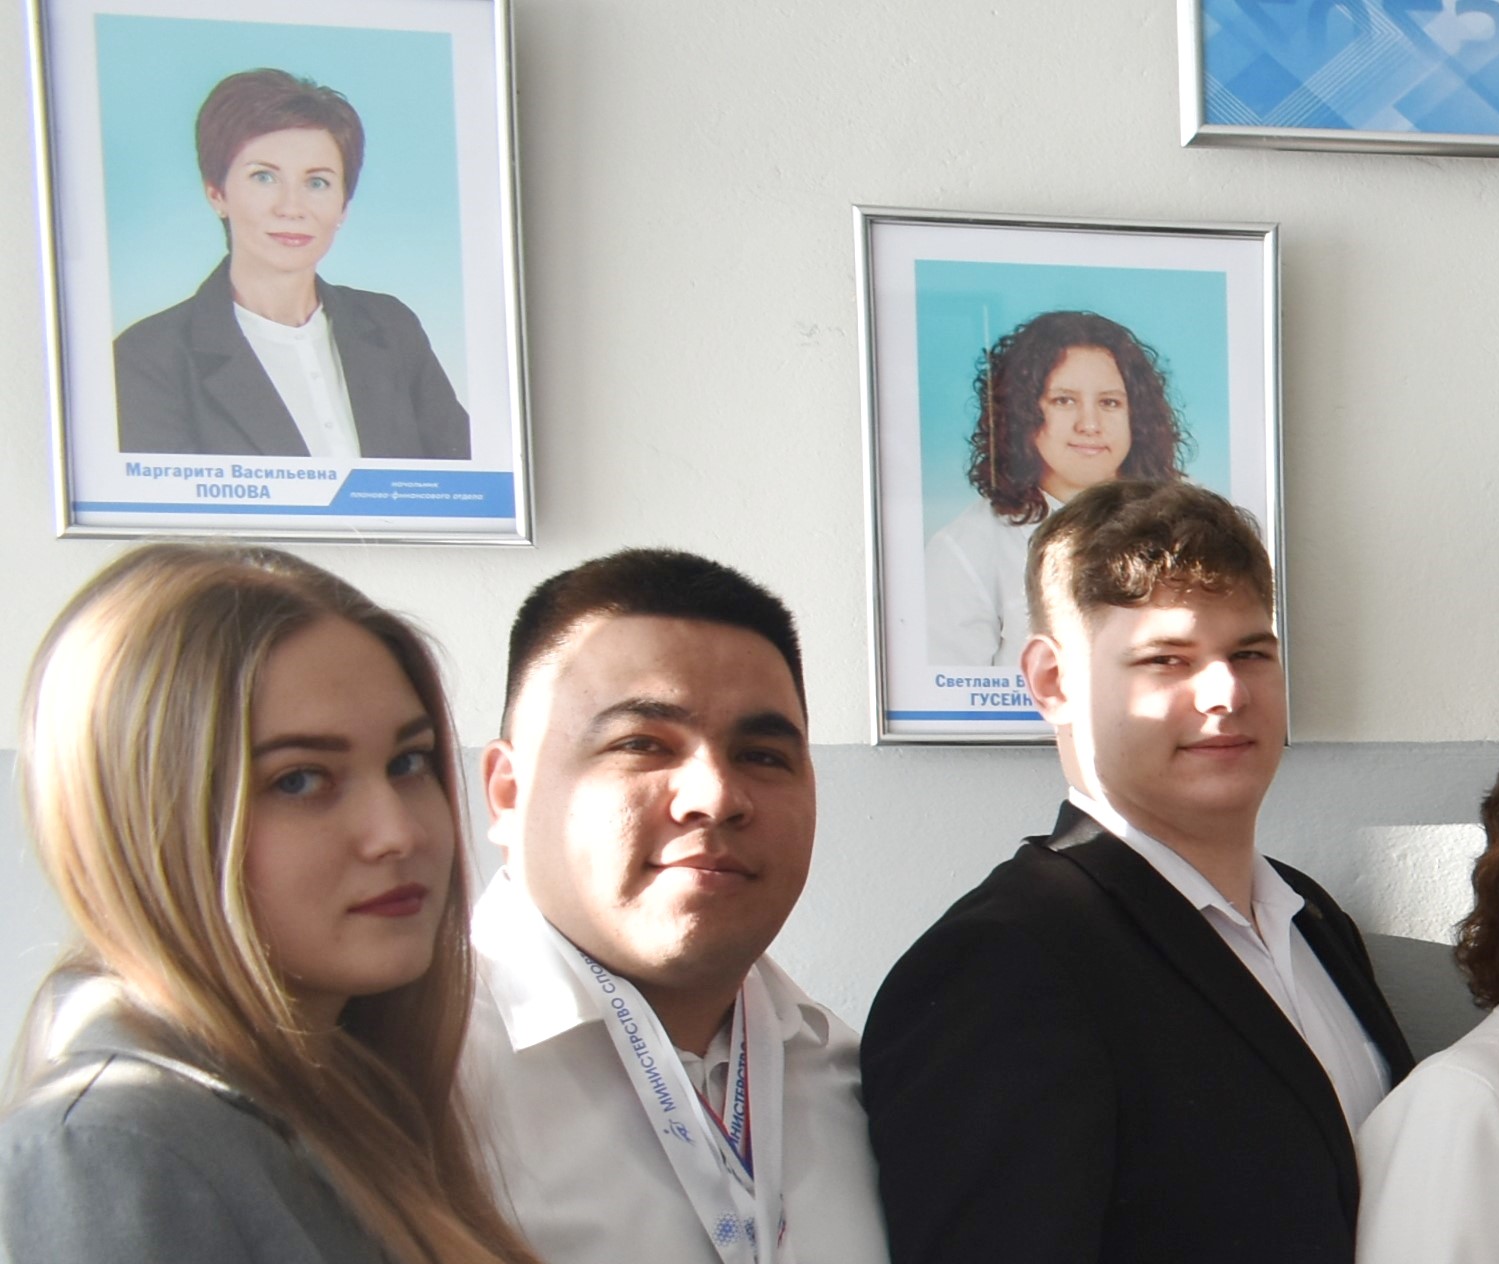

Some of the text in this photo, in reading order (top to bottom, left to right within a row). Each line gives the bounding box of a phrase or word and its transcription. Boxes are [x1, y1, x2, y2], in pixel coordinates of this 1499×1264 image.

[126, 462, 338, 480] Маргарита Васильевна
[196, 483, 272, 499] ПОПОВА
[935, 674, 1010, 687] Светлана
[970, 690, 1033, 706] ГУСЕЙН
[611, 997, 677, 1113] МИНИСТЕРСТВО
